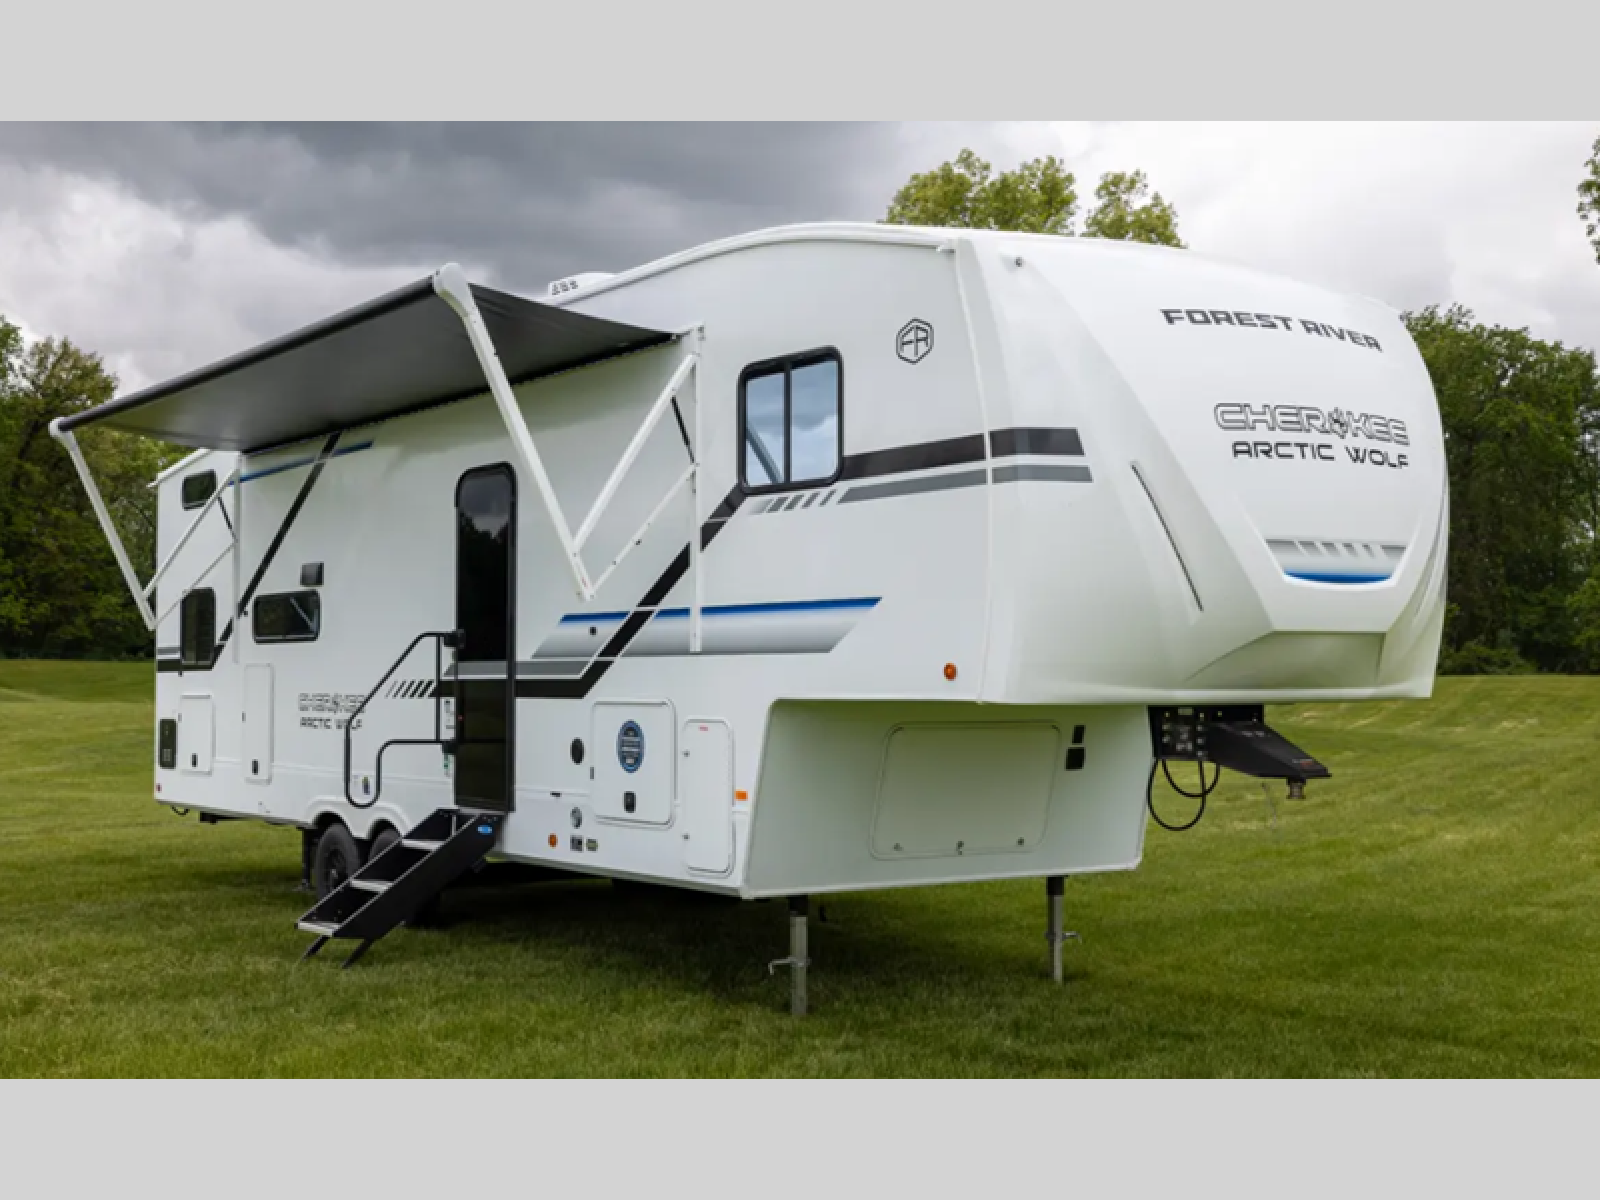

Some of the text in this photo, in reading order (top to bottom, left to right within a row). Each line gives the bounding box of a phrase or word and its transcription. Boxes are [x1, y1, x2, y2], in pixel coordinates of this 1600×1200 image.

[1161, 308, 1383, 353] FOREST RIVER
[1214, 402, 1411, 447] CHEROKEE
[1232, 440, 1409, 469] ARCTIC WOLF
